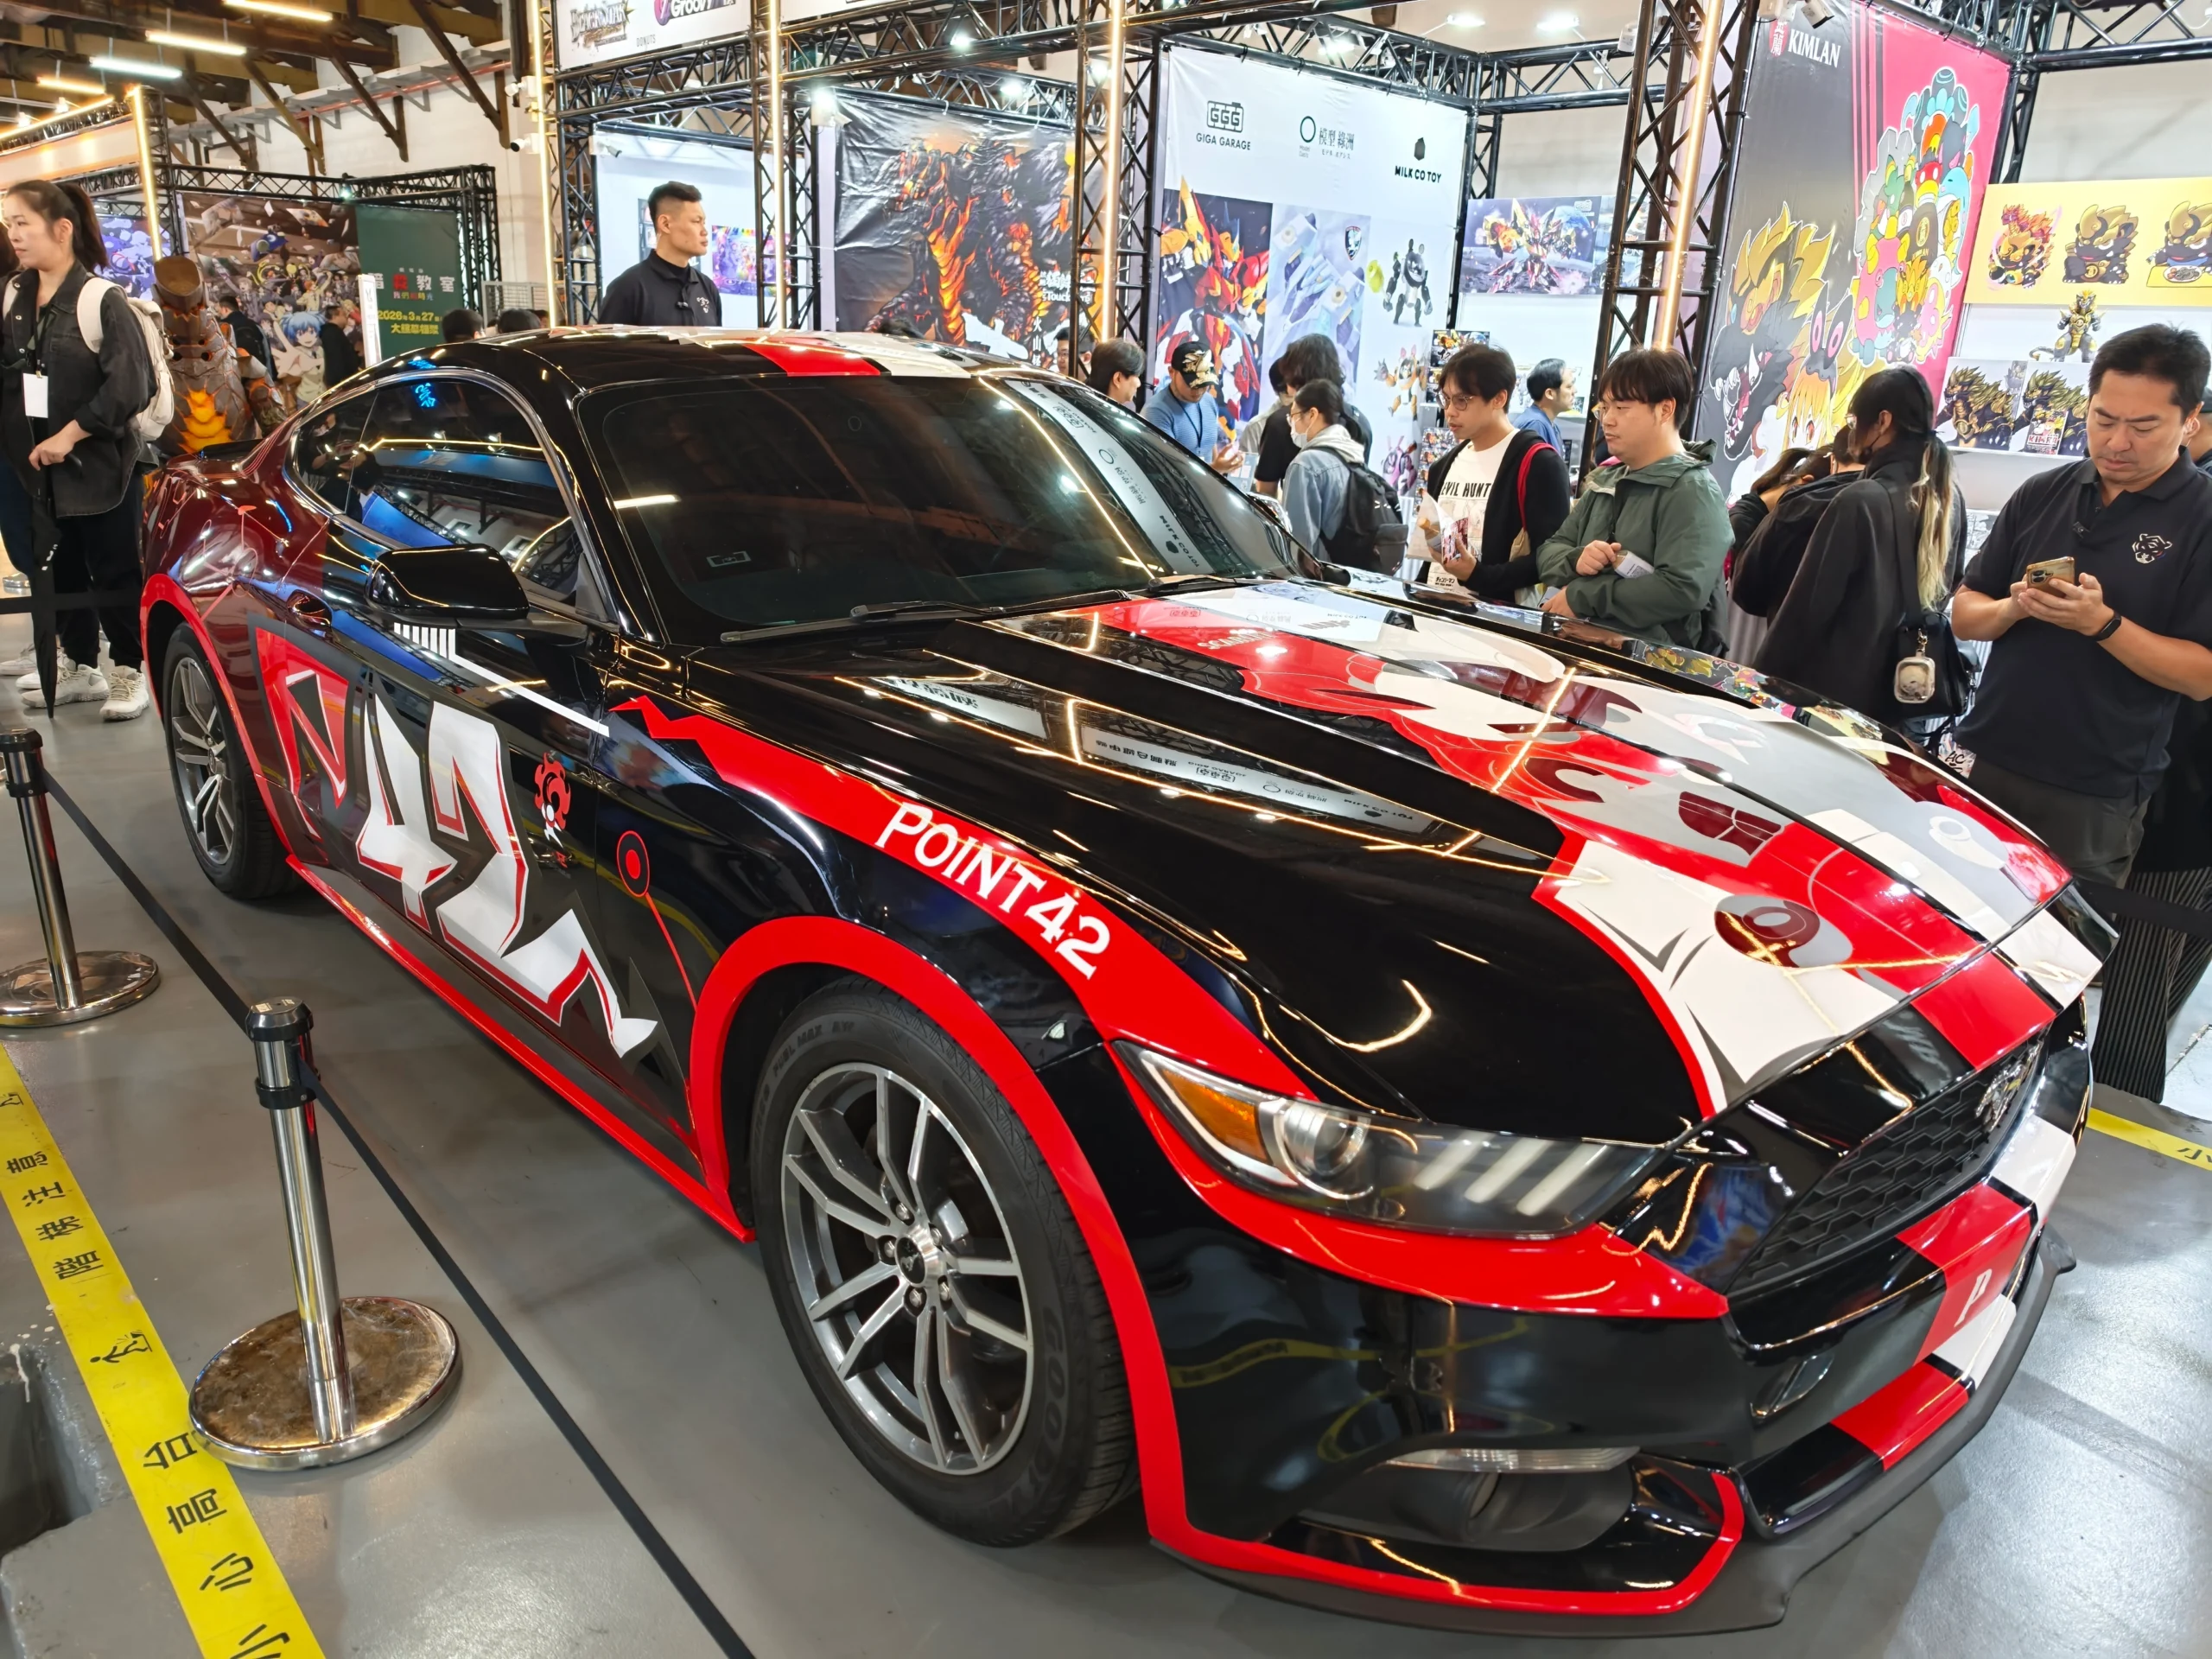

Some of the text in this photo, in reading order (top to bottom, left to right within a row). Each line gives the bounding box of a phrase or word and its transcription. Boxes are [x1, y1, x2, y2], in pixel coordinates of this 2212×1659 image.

[1788, 29, 1841, 68] KIMLAN
[1196, 132, 1251, 150] GIGA GARAGE
[1395, 165, 1442, 183] MILK CO TOY
[6, 1150, 105, 1281] 階梯注意
[142, 1430, 291, 1659] 小心高台
